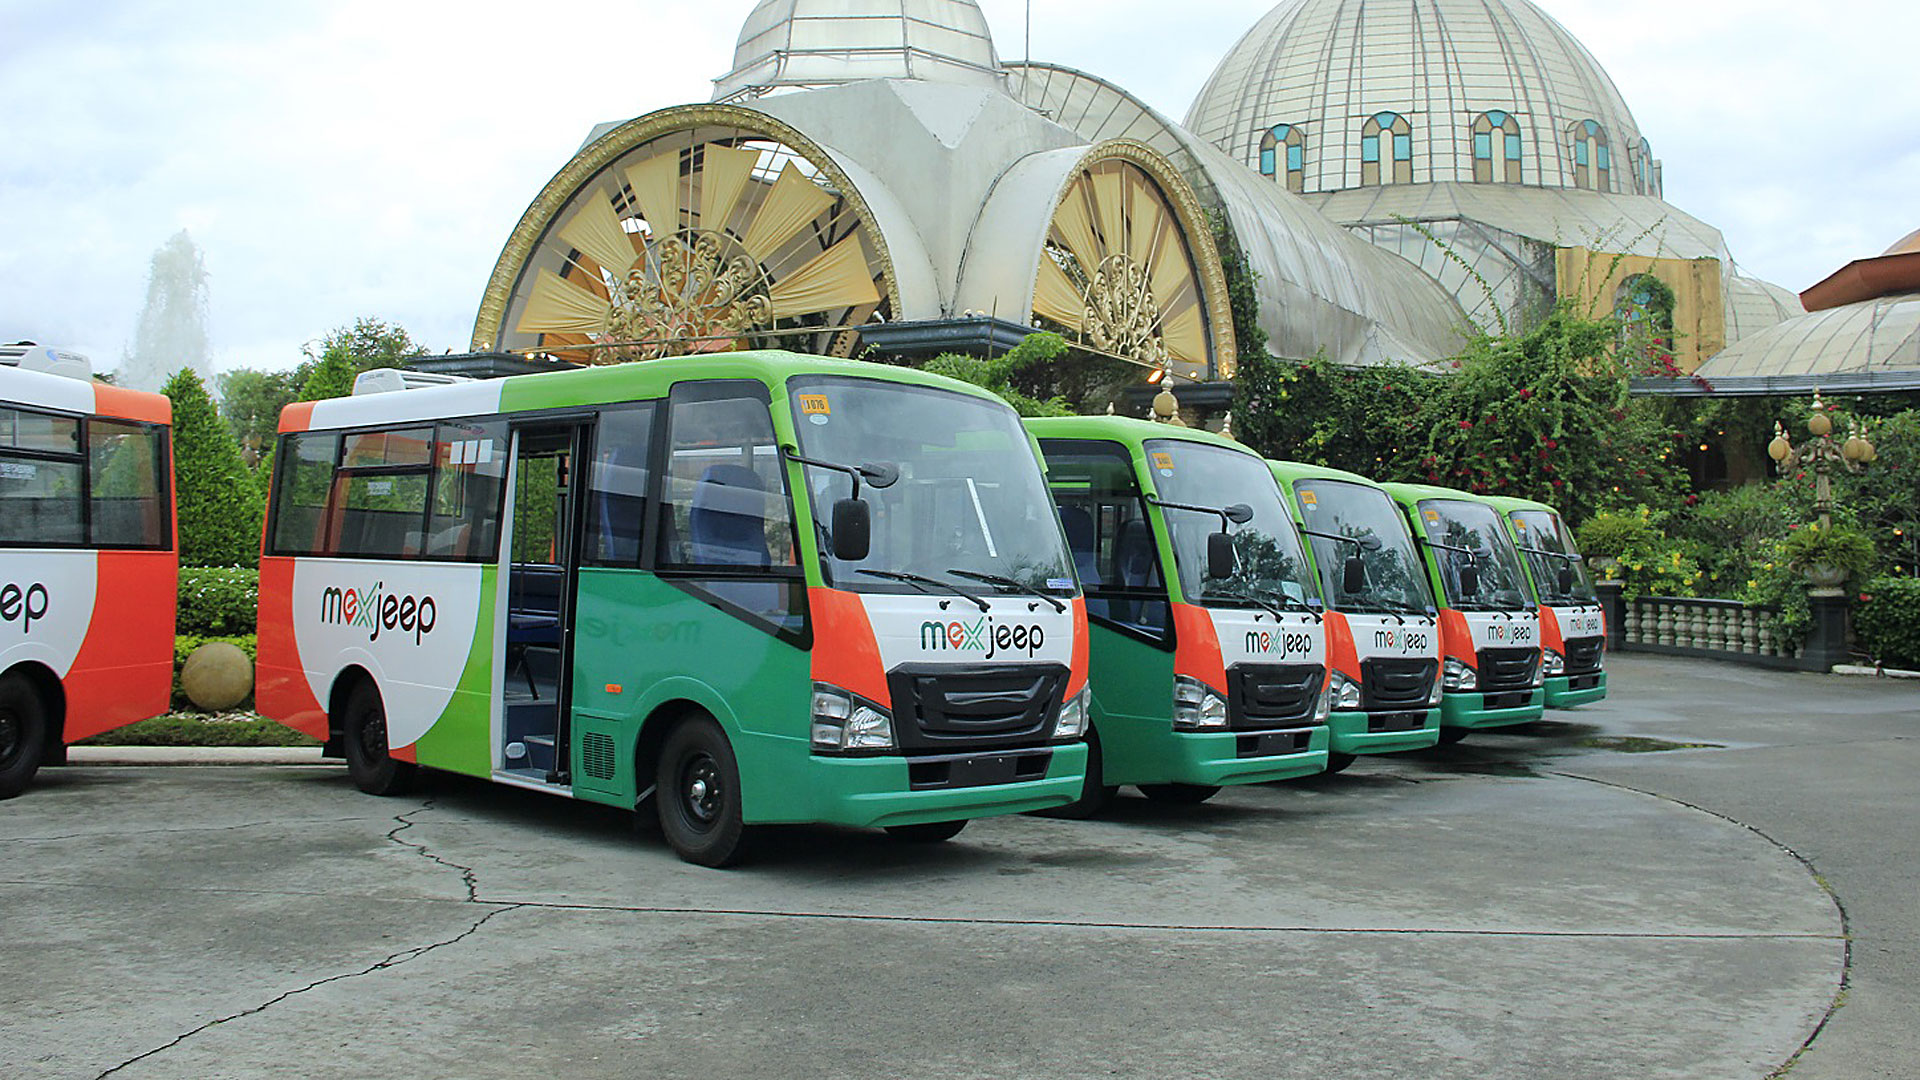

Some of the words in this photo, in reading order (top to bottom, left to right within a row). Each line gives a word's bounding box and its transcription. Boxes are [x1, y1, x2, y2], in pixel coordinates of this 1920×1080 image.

[321, 581, 436, 646] mexjeep
[921, 616, 1043, 660] mexjeep
[1246, 627, 1311, 660] mexjeep
[1375, 628, 1428, 654] mexjeep
[1488, 621, 1531, 644] mexjeep
